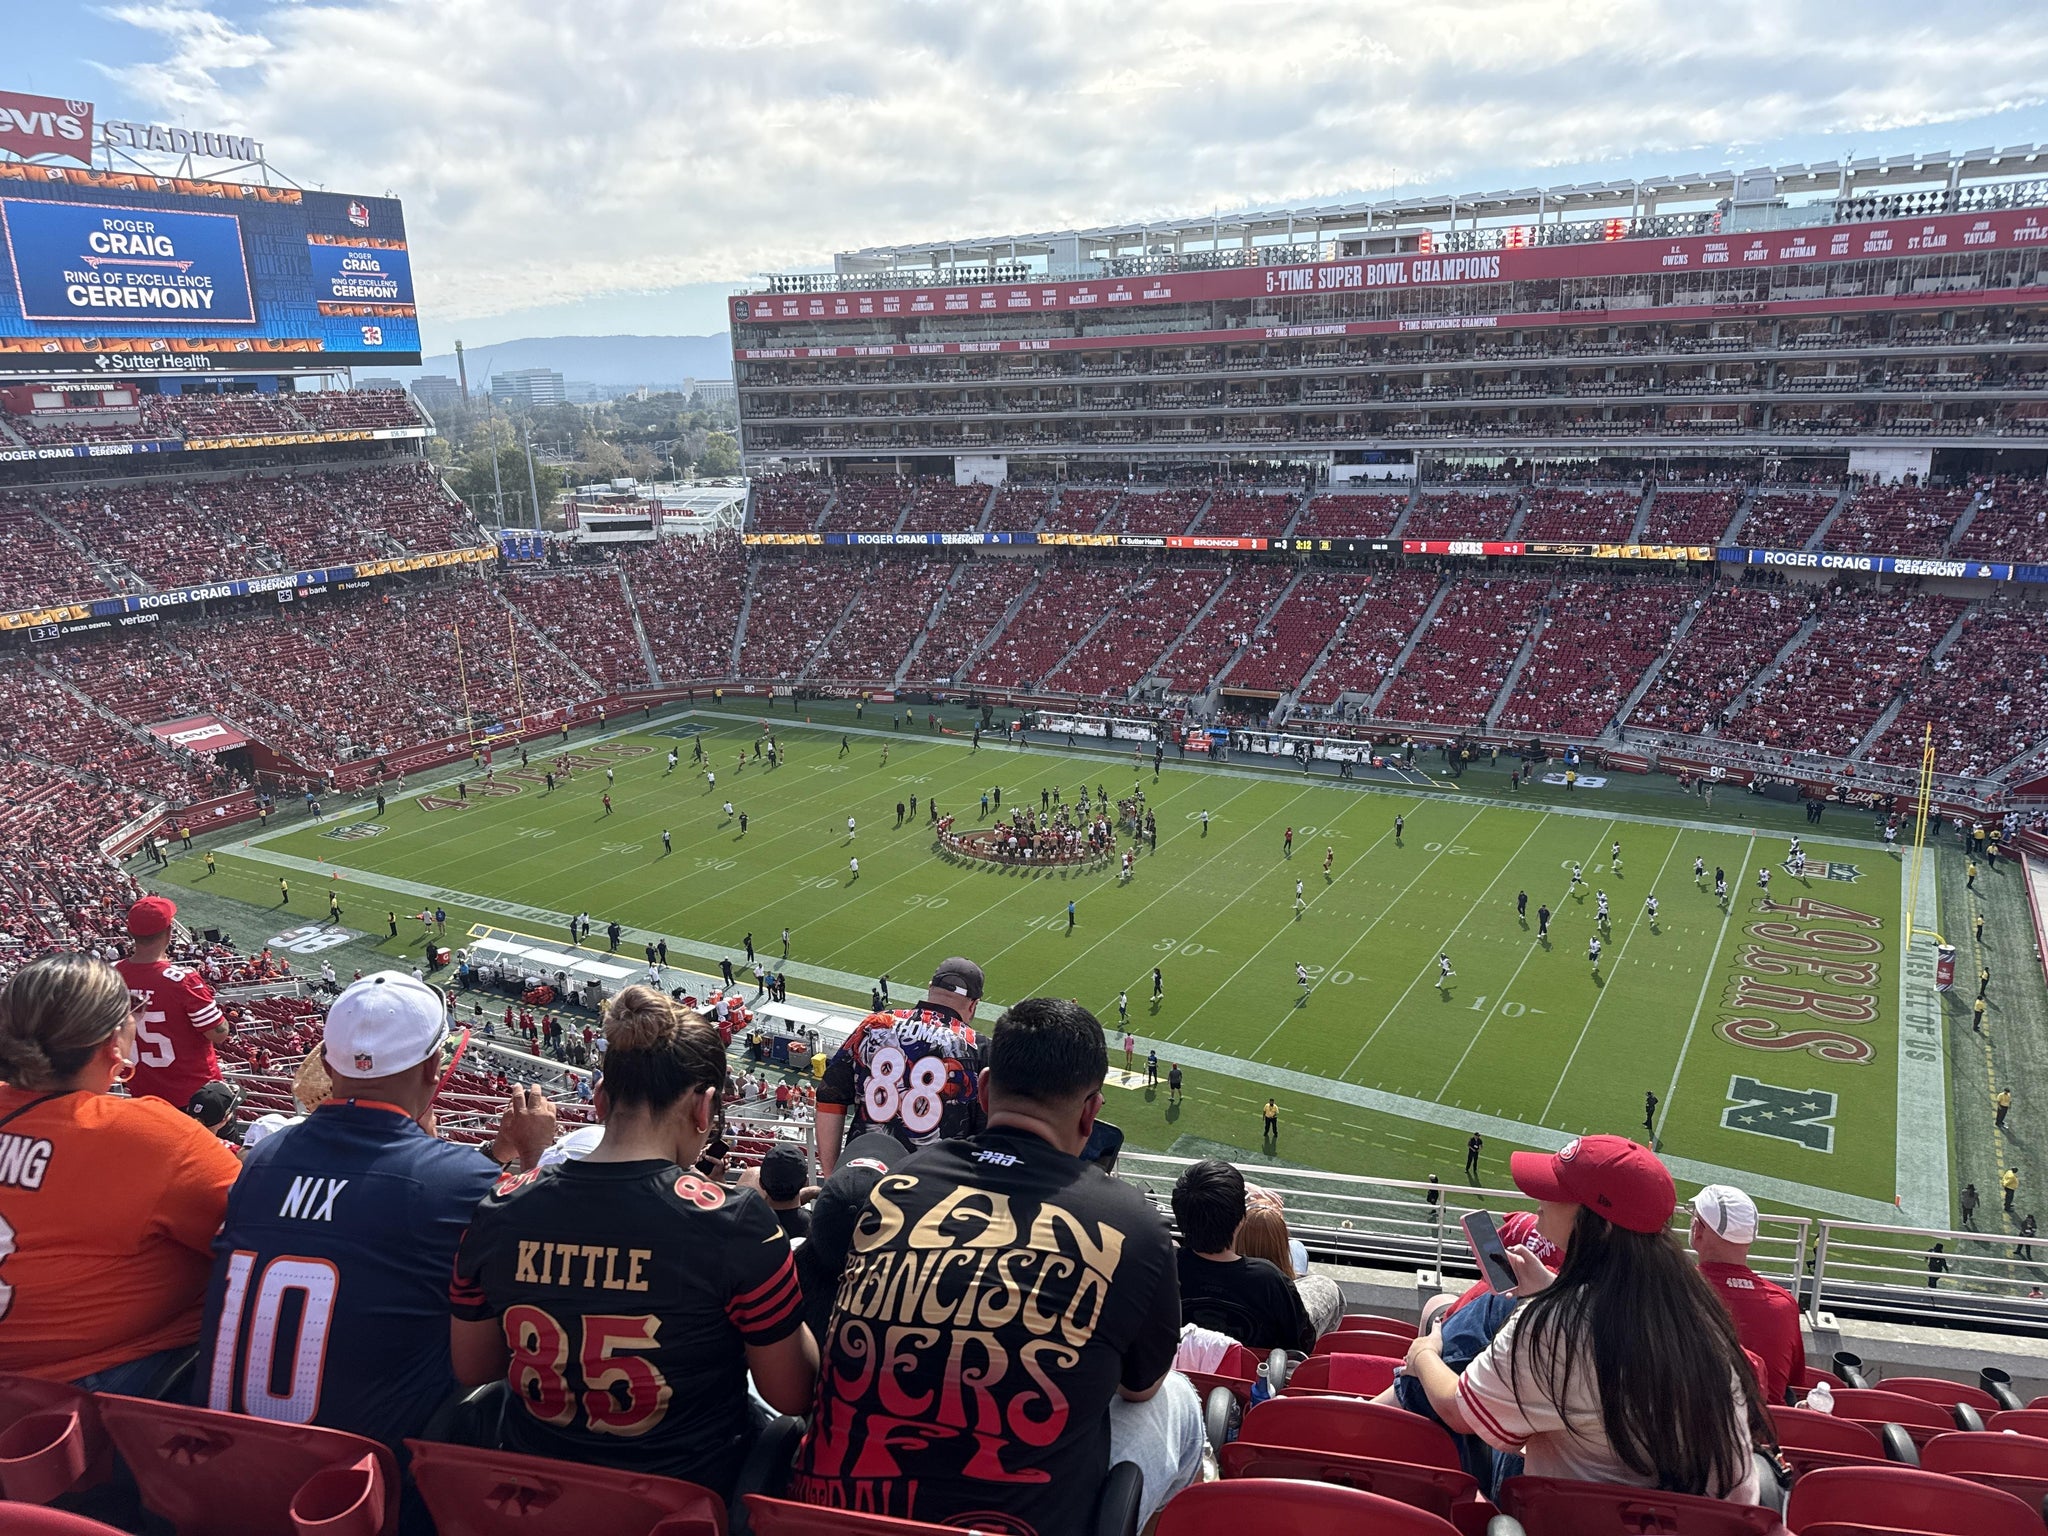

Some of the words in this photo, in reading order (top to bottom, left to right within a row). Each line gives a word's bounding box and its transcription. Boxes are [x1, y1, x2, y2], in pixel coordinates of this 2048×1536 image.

[104, 120, 257, 162] STADIUM
[102, 218, 155, 234] ROGER
[1832, 233, 1850, 242] JERRY
[1963, 231, 1996, 245] TAYLOR
[2012, 227, 2048, 241] TITTLE
[88, 231, 176, 257] CRAIG
[1752, 240, 1763, 249] JOE
[1831, 242, 1848, 255] RICE
[1863, 239, 1893, 252] SOLTAU
[1907, 237, 1920, 250] ST.
[1921, 234, 1948, 248] CLAIR
[348, 252, 373, 260] ROGER
[1702, 252, 1729, 264] OWENS
[1743, 249, 1769, 262] PERRY
[1780, 245, 1817, 259] RATHMAN
[341, 259, 381, 272] CRAIG
[1662, 254, 1689, 266] OWENS
[63, 269, 99, 285] RING
[103, 272, 124, 285] OF
[126, 272, 213, 289] EXCELLENCE
[1266, 268, 1314, 293] 5-TIME
[1318, 265, 1362, 290] SUPER
[1366, 261, 1408, 287] BOWL
[1411, 255, 1500, 283] CHAMPIONS
[331, 278, 347, 286] RING
[348, 279, 358, 287] OF
[358, 279, 398, 288] EXCELLENCE
[66, 284, 215, 309] CEREMONY
[333, 285, 399, 298] CEREMONY
[1108, 291, 1132, 302] MONTANA
[911, 301, 934, 312] JOHNSON
[945, 300, 968, 311] JOHNSON
[980, 299, 996, 309] JONES
[1043, 296, 1057, 306] LOTT
[783, 307, 800, 317] CLARK
[835, 305, 849, 315] DEAN
[884, 303, 901, 313] HALEY
[1421, 318, 1461, 330] CONFERENCE
[1461, 317, 1498, 328] CHAMPIONS
[1266, 326, 1288, 338] 22-TIME
[1289, 325, 1312, 337] DIVISION
[1313, 324, 1347, 336] CHAMPIONS
[854, 347, 868, 356] TONY
[1019, 341, 1031, 350] BILL
[1032, 340, 1050, 349] WALSH
[111, 353, 161, 369] Sutter
[163, 353, 211, 369] Health
[81, 383, 114, 392] STADIUM
[0, 449, 37, 462] ROGER
[39, 447, 75, 460] CRAIG
[89, 447, 134, 458] CEREMONY
[858, 535, 895, 544] ROGER
[896, 535, 928, 544] CRAIG
[941, 537, 985, 545] CEREMONY
[1126, 537, 1145, 546] Sutter
[1145, 537, 1164, 546] Health
[1193, 539, 1240, 547] BRONCOS
[1295, 540, 1312, 550] 3:12
[1420, 542, 1427, 552] 3
[1447, 541, 1484, 555] 49ERS
[1512, 545, 1518, 554] 3
[1763, 551, 1817, 567] ROGER
[1821, 555, 1871, 570] CRAIG
[1893, 565, 1966, 578] CEREMONY
[248, 581, 298, 594] CEREMONY
[299, 589, 309, 597] us
[309, 586, 328, 596] bank
[346, 582, 370, 591] NetApp
[139, 592, 188, 609] ROGER
[190, 587, 232, 602] CRAIG
[119, 612, 160, 627] verizon
[37, 627, 58, 638] 3:12
[70, 624, 88, 633] DELTA
[88, 620, 112, 631] DENTAL
[772, 686, 798, 698] HOM
[820, 685, 861, 698] Faithful
[219, 742, 247, 754] STADIUM
[414, 743, 657, 812] 49ERS
[1319, 779, 1410, 797] CANCER
[1808, 785, 1828, 796] THE
[1418, 791, 1555, 812] INTERCEPT
[518, 826, 557, 839] 10
[602, 841, 645, 854] 20
[696, 857, 739, 871] 30
[798, 875, 840, 889] 40
[431, 889, 512, 913] CANCER
[904, 894, 949, 910] 50
[519, 906, 637, 939] ITECEPT
[1026, 915, 1069, 931] 40
[1153, 937, 1206, 957] 30
[1305, 965, 1356, 984] 20
[1712, 896, 1885, 1066] 49ERS
[1906, 982, 1936, 1008] ALL
[1466, 996, 1528, 1020] 10
[1905, 1014, 1936, 1036] OF
[130, 1011, 177, 1069] 5
[893, 1018, 955, 1050] THOMAS
[1904, 1039, 1938, 1063] US
[865, 1045, 950, 1134] 88
[0, 1133, 53, 1192] NG
[277, 1175, 349, 1223] NIX
[852, 1173, 1127, 1285] SAN
[514, 1239, 653, 1294] KITTLE
[1726, 1277, 1755, 1290] 49ERS
[837, 1247, 1113, 1349] FRANCISCO
[208, 1249, 341, 1426] 10
[502, 1303, 674, 1438] 85
